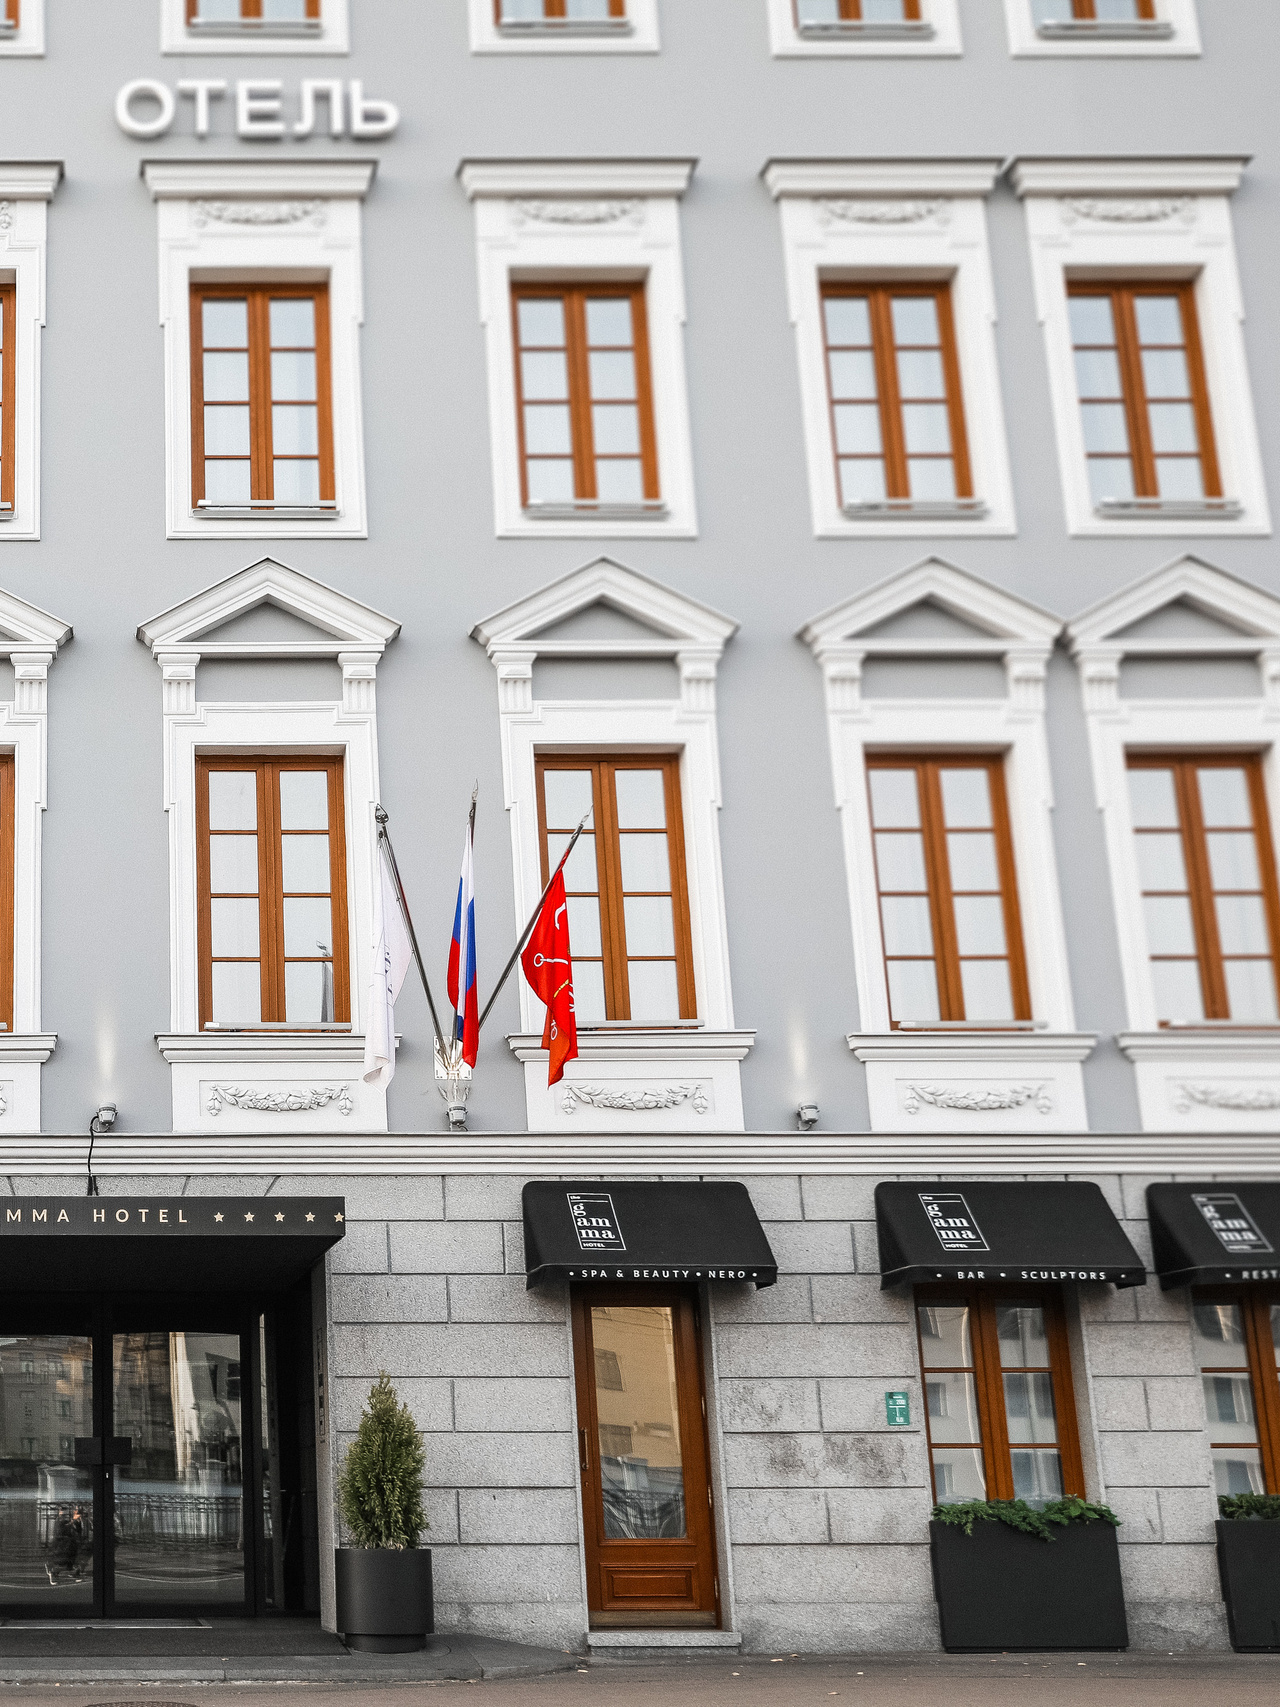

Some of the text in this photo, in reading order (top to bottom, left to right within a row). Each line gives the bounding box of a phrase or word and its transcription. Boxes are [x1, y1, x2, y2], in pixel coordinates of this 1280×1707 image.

[114, 78, 400, 138] ОТЕЛЬ
[93, 1208, 188, 1222] HOTEL
[581, 1269, 746, 1279] SPA & BEAUTY NERO
[957, 1271, 1107, 1280] BAR SCULPTORS
[1242, 1269, 1280, 1280] REST
